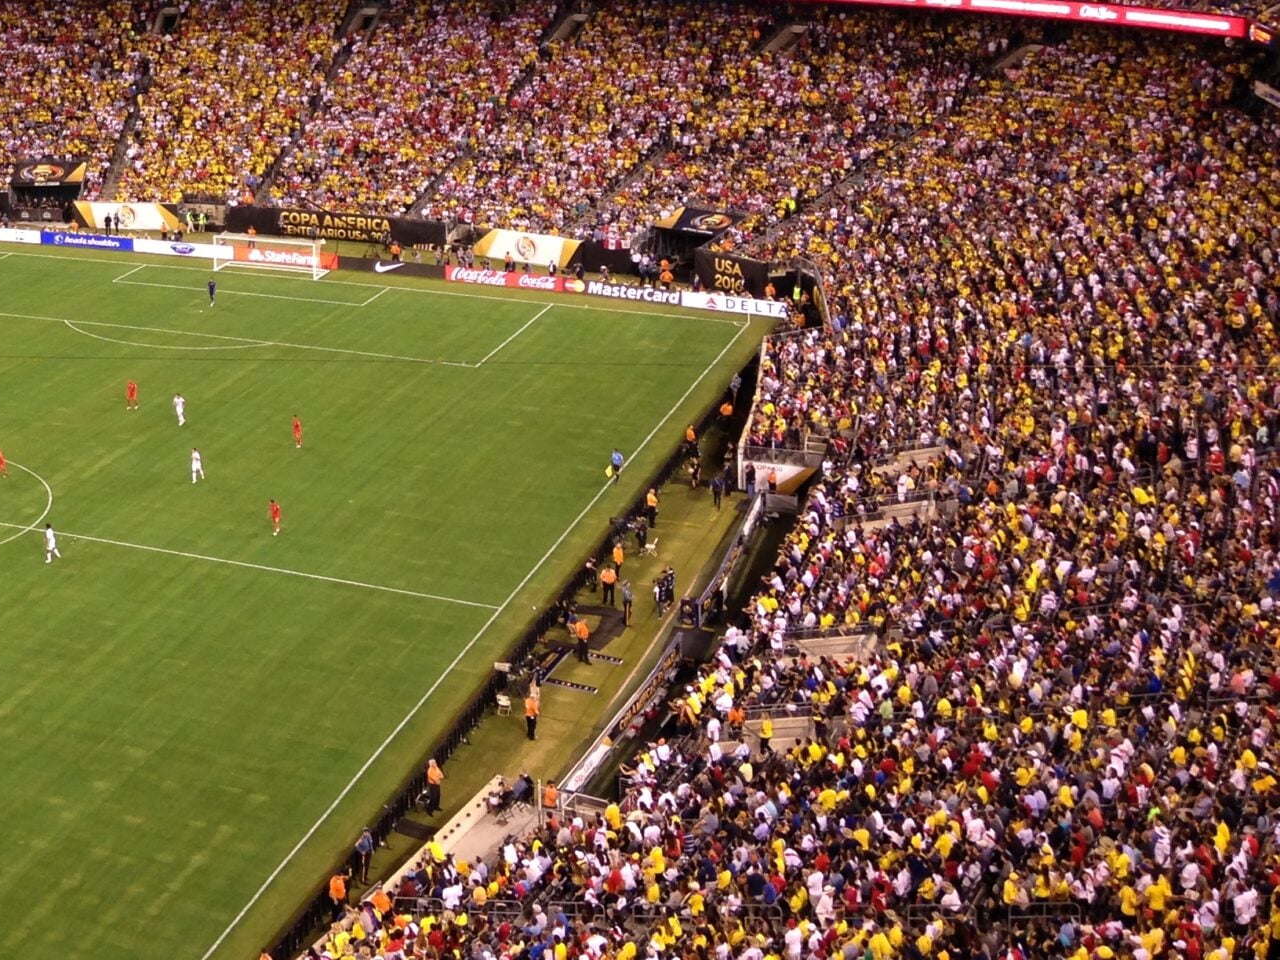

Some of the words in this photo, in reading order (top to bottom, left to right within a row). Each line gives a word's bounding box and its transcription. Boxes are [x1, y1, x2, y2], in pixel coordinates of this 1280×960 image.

[280, 211, 320, 227] COPA
[323, 214, 392, 232] AMERICA
[714, 258, 742, 276] USA
[714, 274, 744, 291] 2016
[588, 281, 680, 304] MasterCard
[726, 299, 787, 316] DELTA
